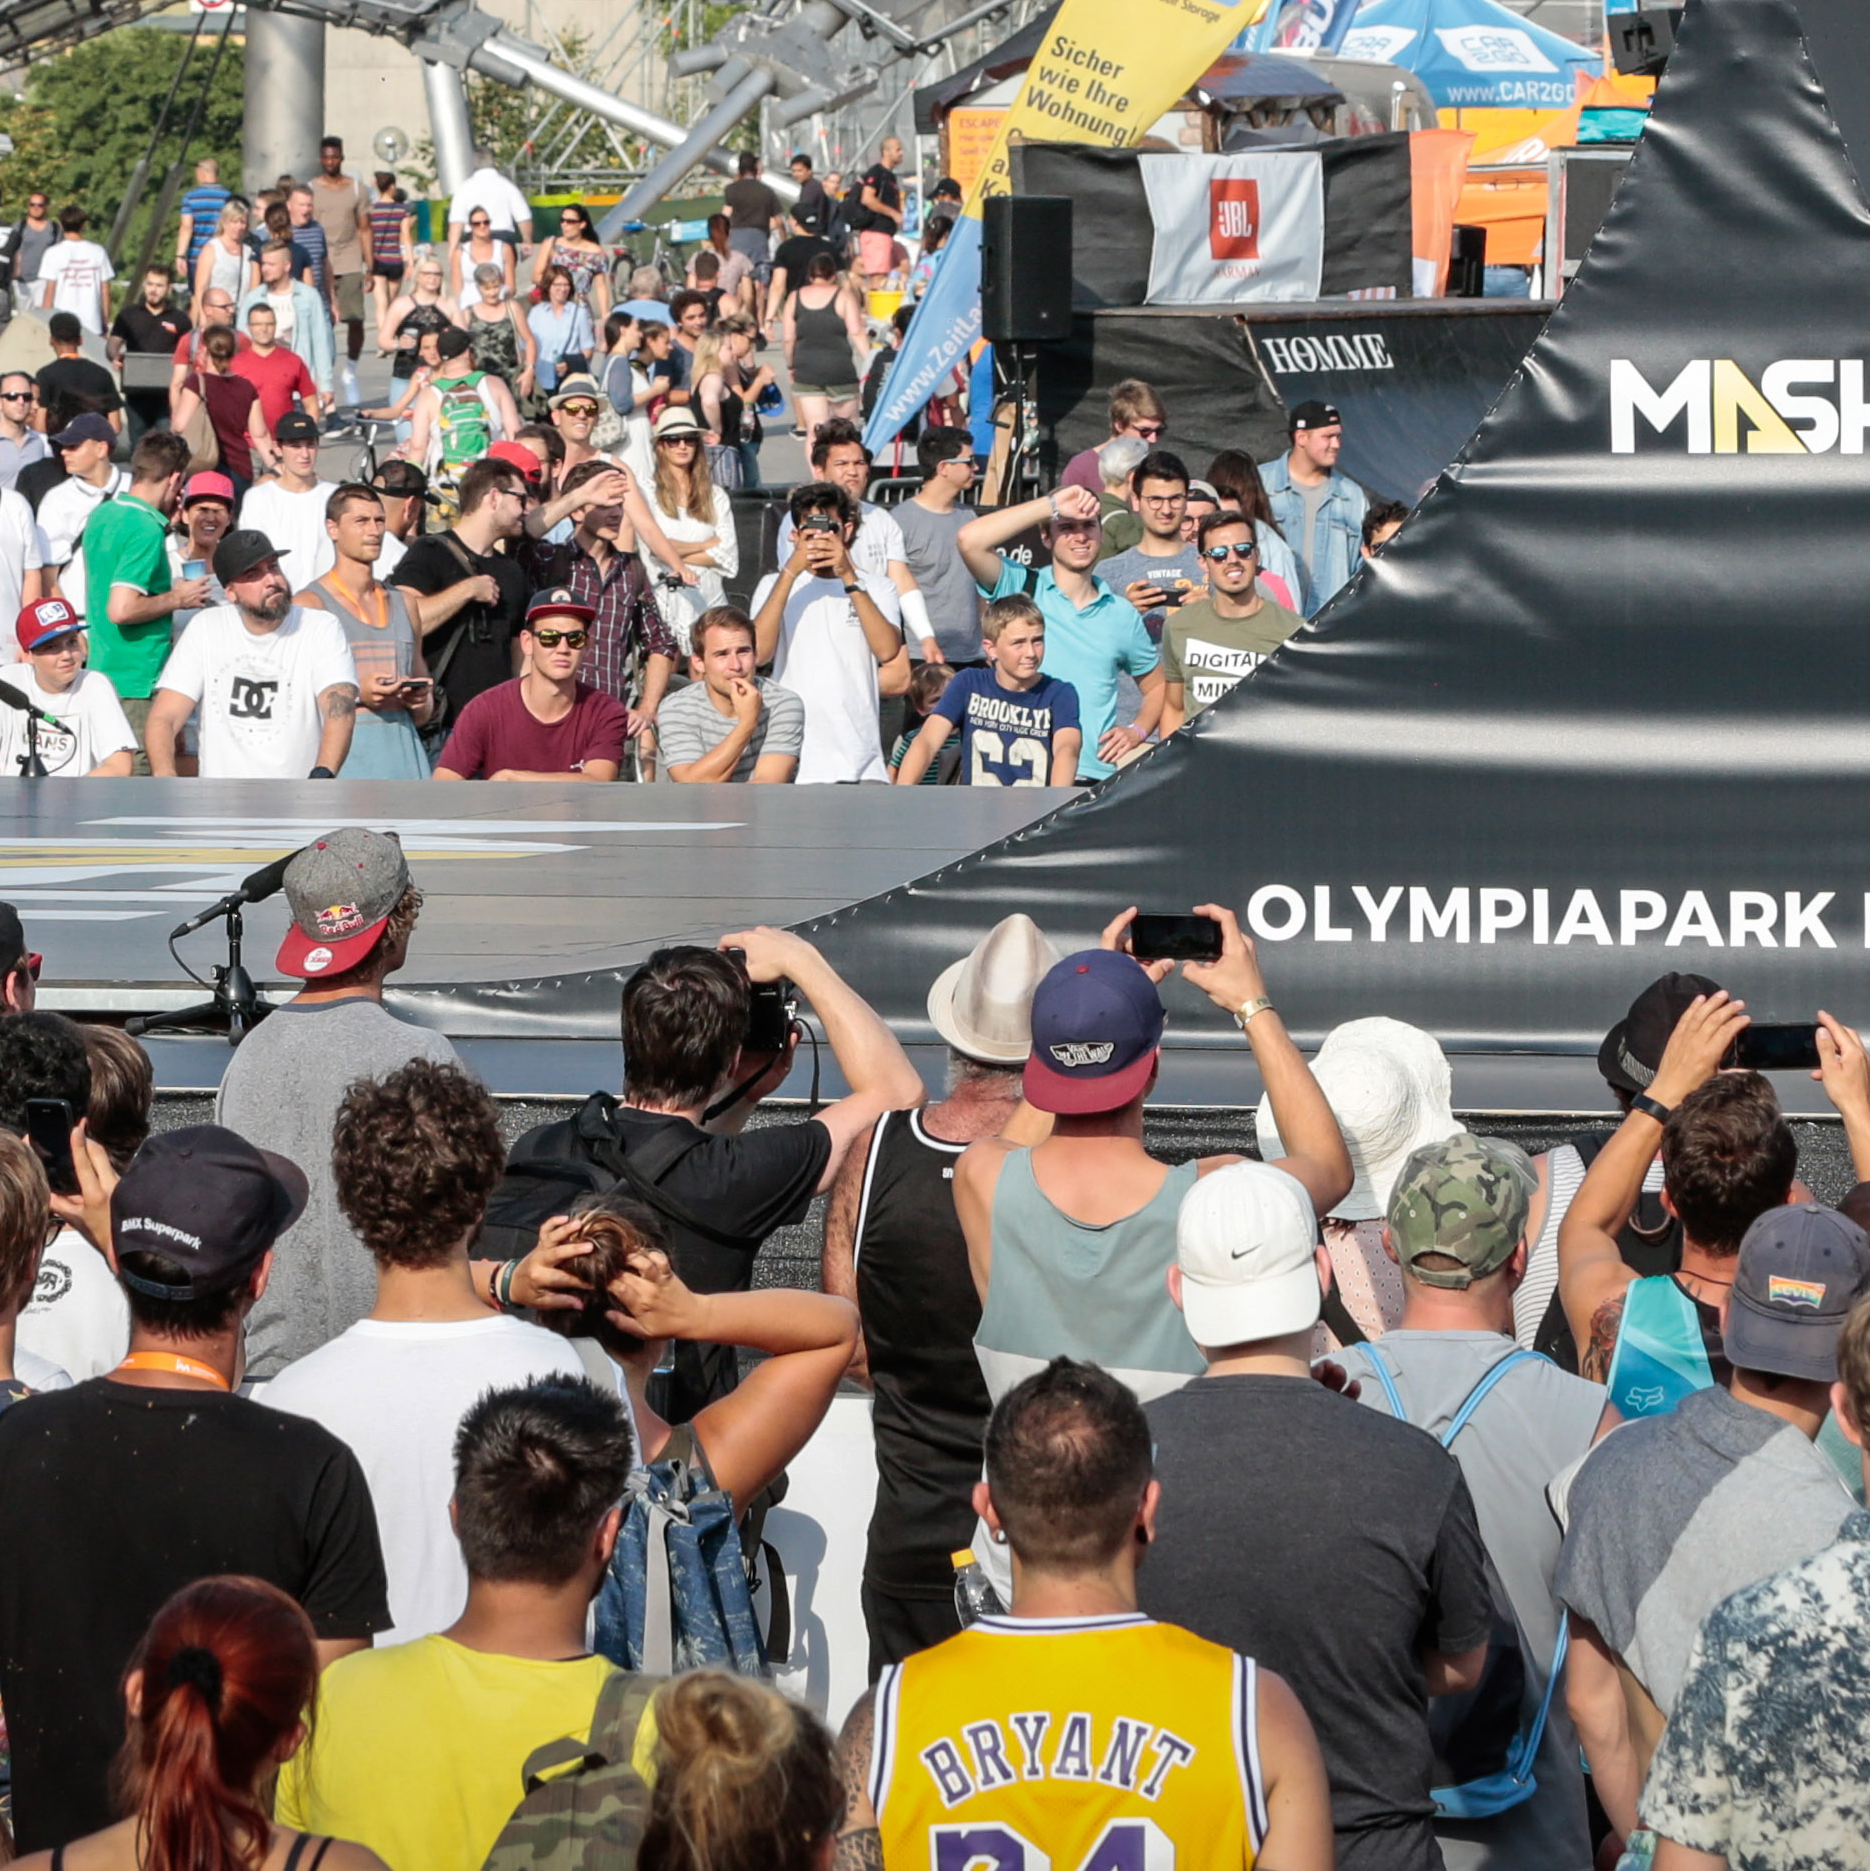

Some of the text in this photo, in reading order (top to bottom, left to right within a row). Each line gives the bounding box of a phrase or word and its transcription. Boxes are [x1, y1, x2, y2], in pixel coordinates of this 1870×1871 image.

[1051, 36, 1124, 79] Sicher
[1039, 66, 1129, 112] wie Ihre
[1026, 86, 1137, 148] Wohnung!
[1219, 201, 1253, 239] JBL
[1147, 569, 1183, 580] VINTAGE
[1189, 651, 1261, 668] DIGITAL
[230, 677, 278, 719] DC
[999, 723, 1013, 733] CITY
[1246, 884, 1835, 948] OLYMPIAPARK
[1072, 1050, 1088, 1061] THE
[121, 1217, 202, 1251] BMX Superpark
[920, 1711, 1197, 1810] BRYANT
